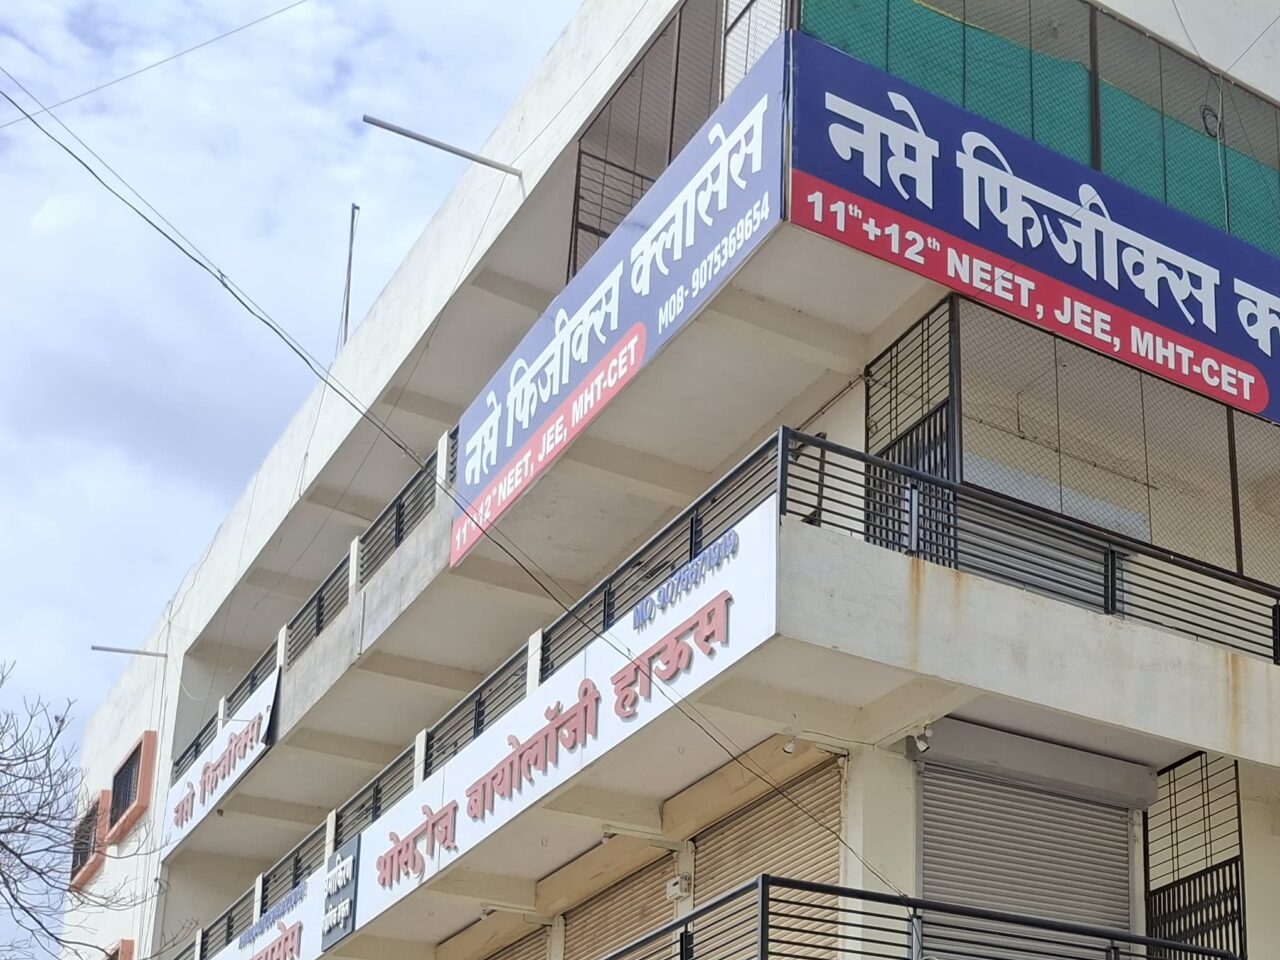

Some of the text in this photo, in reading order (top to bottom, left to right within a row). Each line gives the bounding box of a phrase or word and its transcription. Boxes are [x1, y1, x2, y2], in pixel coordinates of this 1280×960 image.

[506, 260, 623, 448] फिजीक्स
[631, 93, 768, 296] क्लासेस
[658, 190, 770, 335] MOB- 9075369654
[946, 246, 1045, 321] NEET,
[1054, 296, 1121, 352] JEE,
[1130, 329, 1256, 400] MHT-CET
[957, 131, 1220, 333] फिजीक्स
[498, 449, 535, 502] NEET,
[537, 413, 568, 463] JEE,
[571, 333, 639, 427] MHT-CET
[466, 589, 734, 820] बायोलॉजी हाऊस
